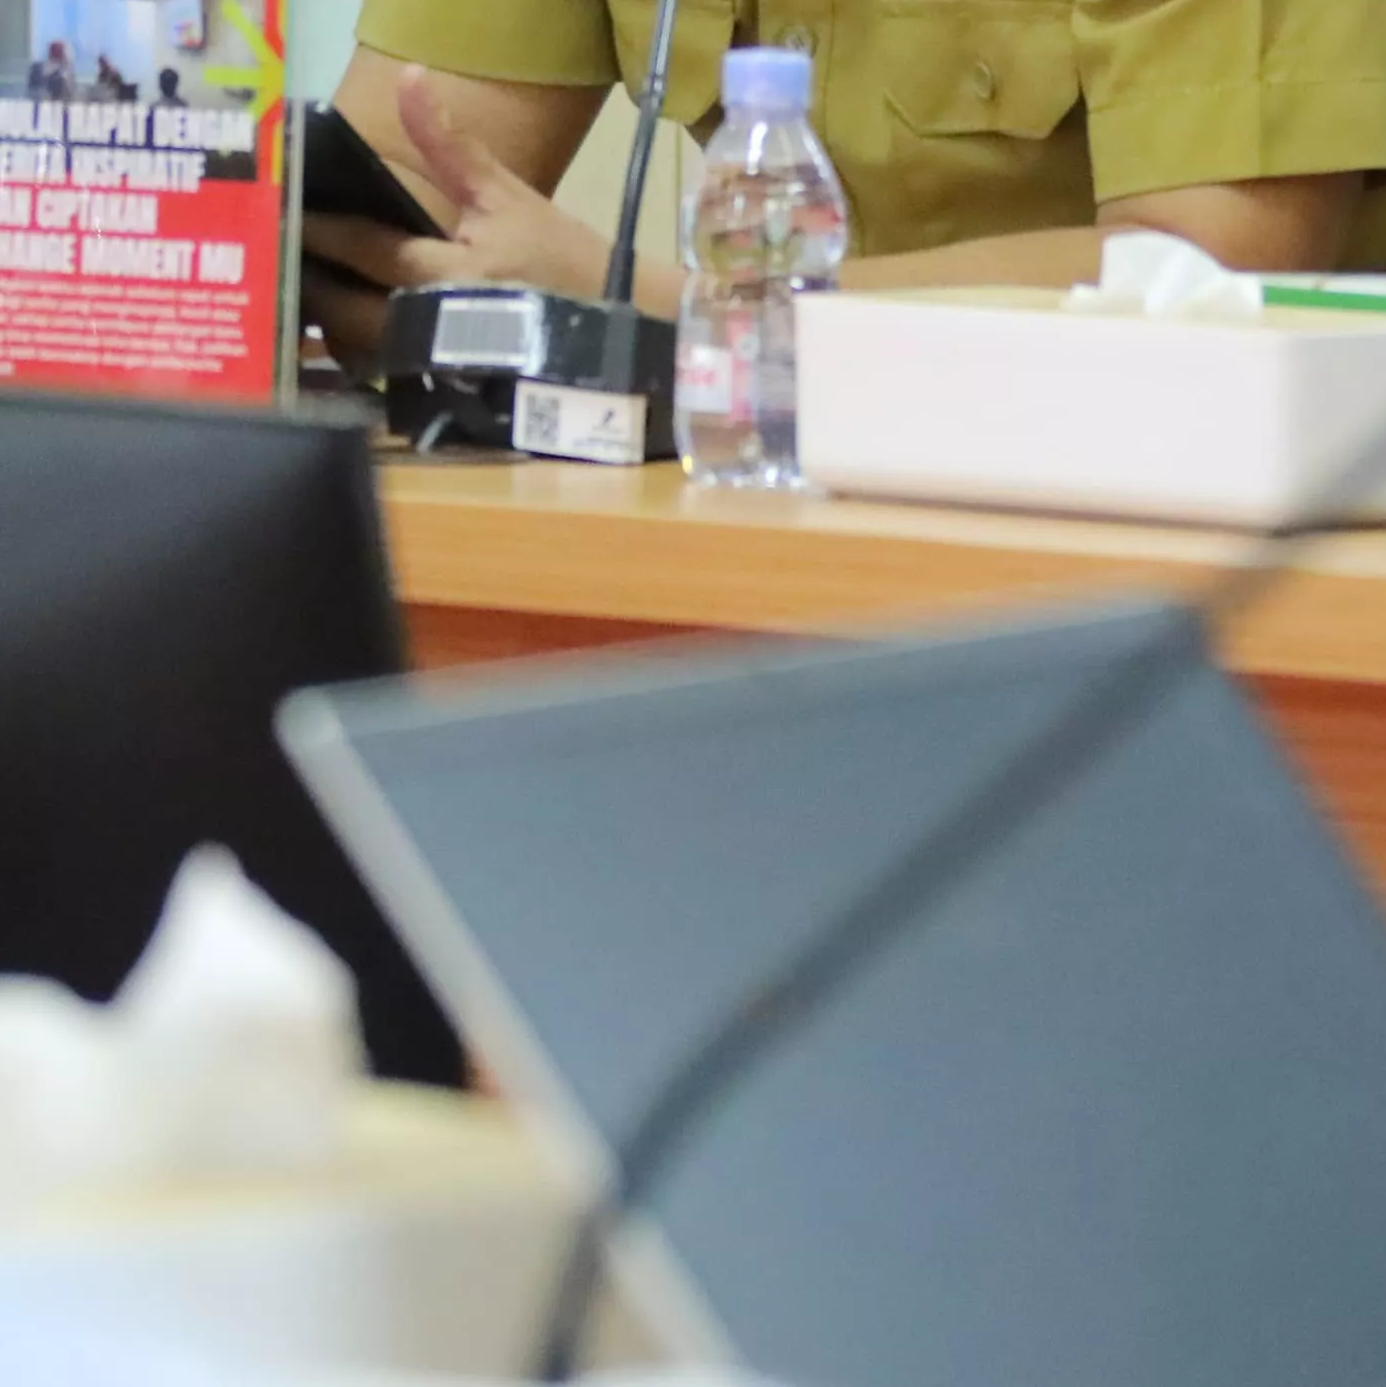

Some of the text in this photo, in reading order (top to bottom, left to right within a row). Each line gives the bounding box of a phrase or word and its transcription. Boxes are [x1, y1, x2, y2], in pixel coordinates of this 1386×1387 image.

[72, 150, 205, 192] INSPIRATIF
[37, 191, 157, 233] CIPTAKAN
[82, 238, 194, 280] MOMENT
